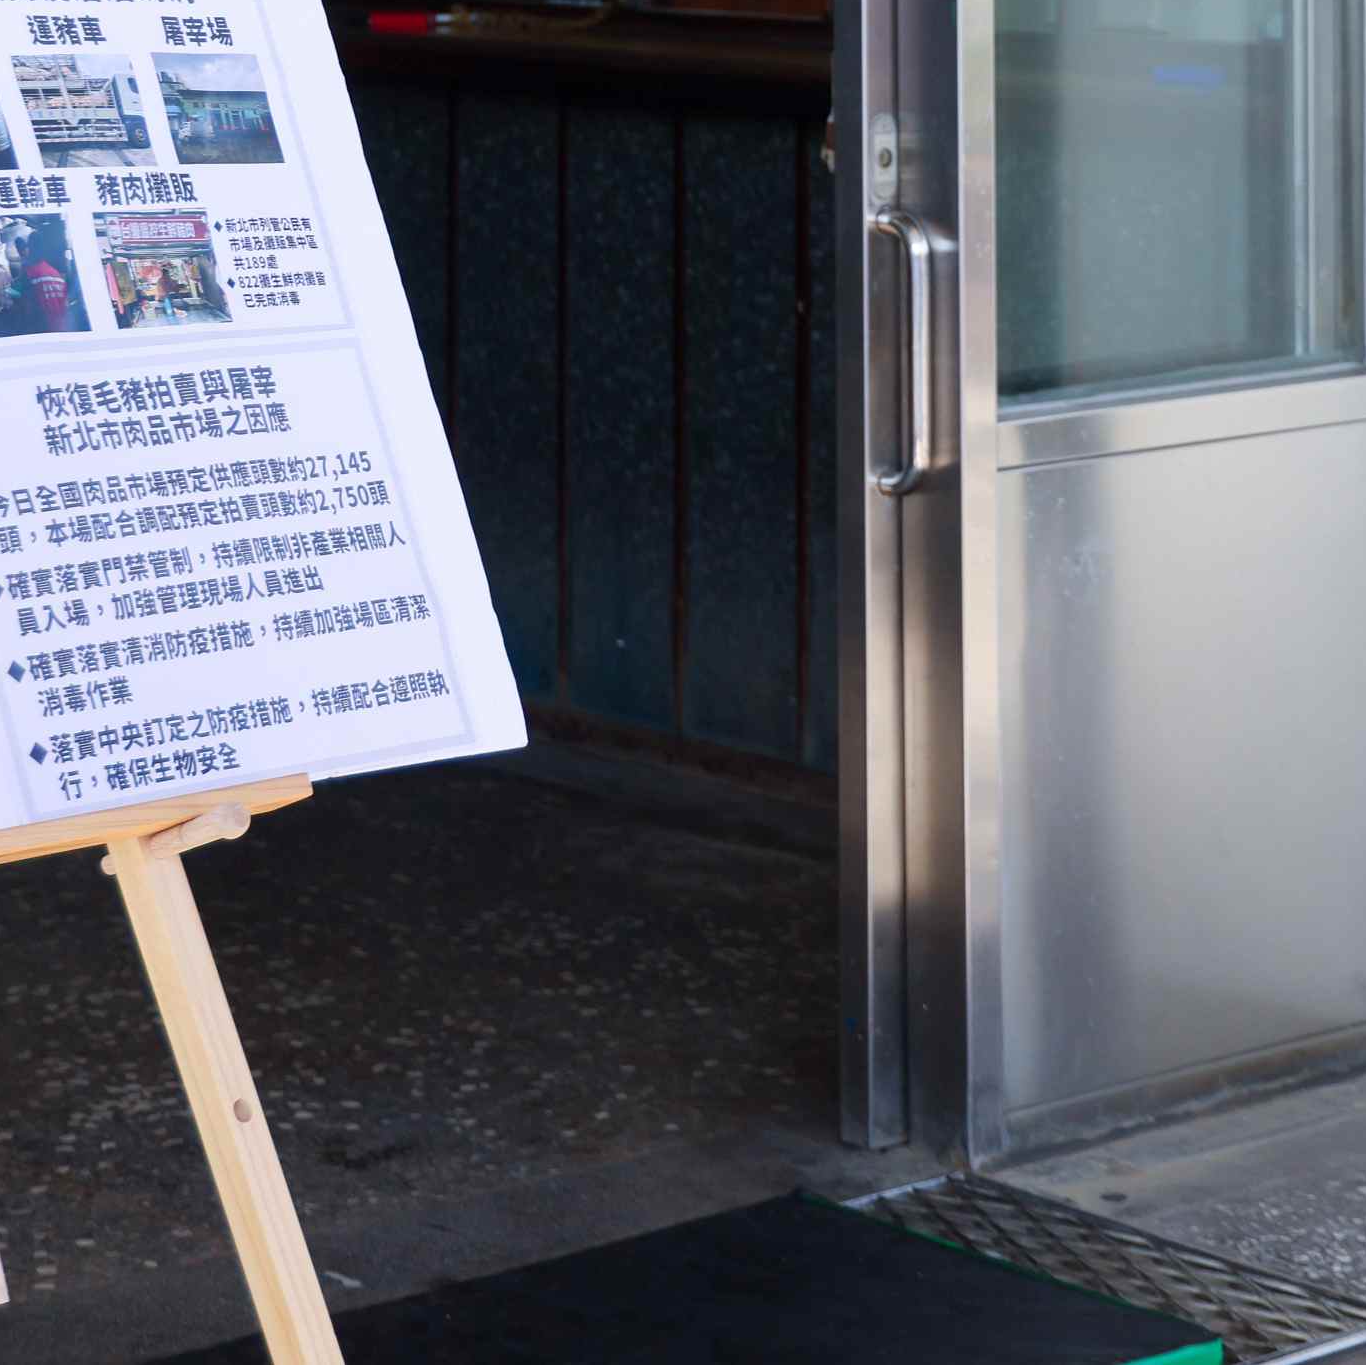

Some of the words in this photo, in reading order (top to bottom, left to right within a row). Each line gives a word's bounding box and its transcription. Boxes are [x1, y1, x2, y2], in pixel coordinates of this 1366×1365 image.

[26, 15, 107, 47] 運豬車
[161, 16, 233, 47] 屠宰場
[94, 172, 198, 207] 豬肉攤販
[36, 365, 278, 421] 恢復毛豬拍賣與屠宰
[43, 401, 292, 457] 新北市肉品市場之因應
[38, 675, 135, 718] 消毒作業
[59, 747, 242, 802] 行，確保生物安全
